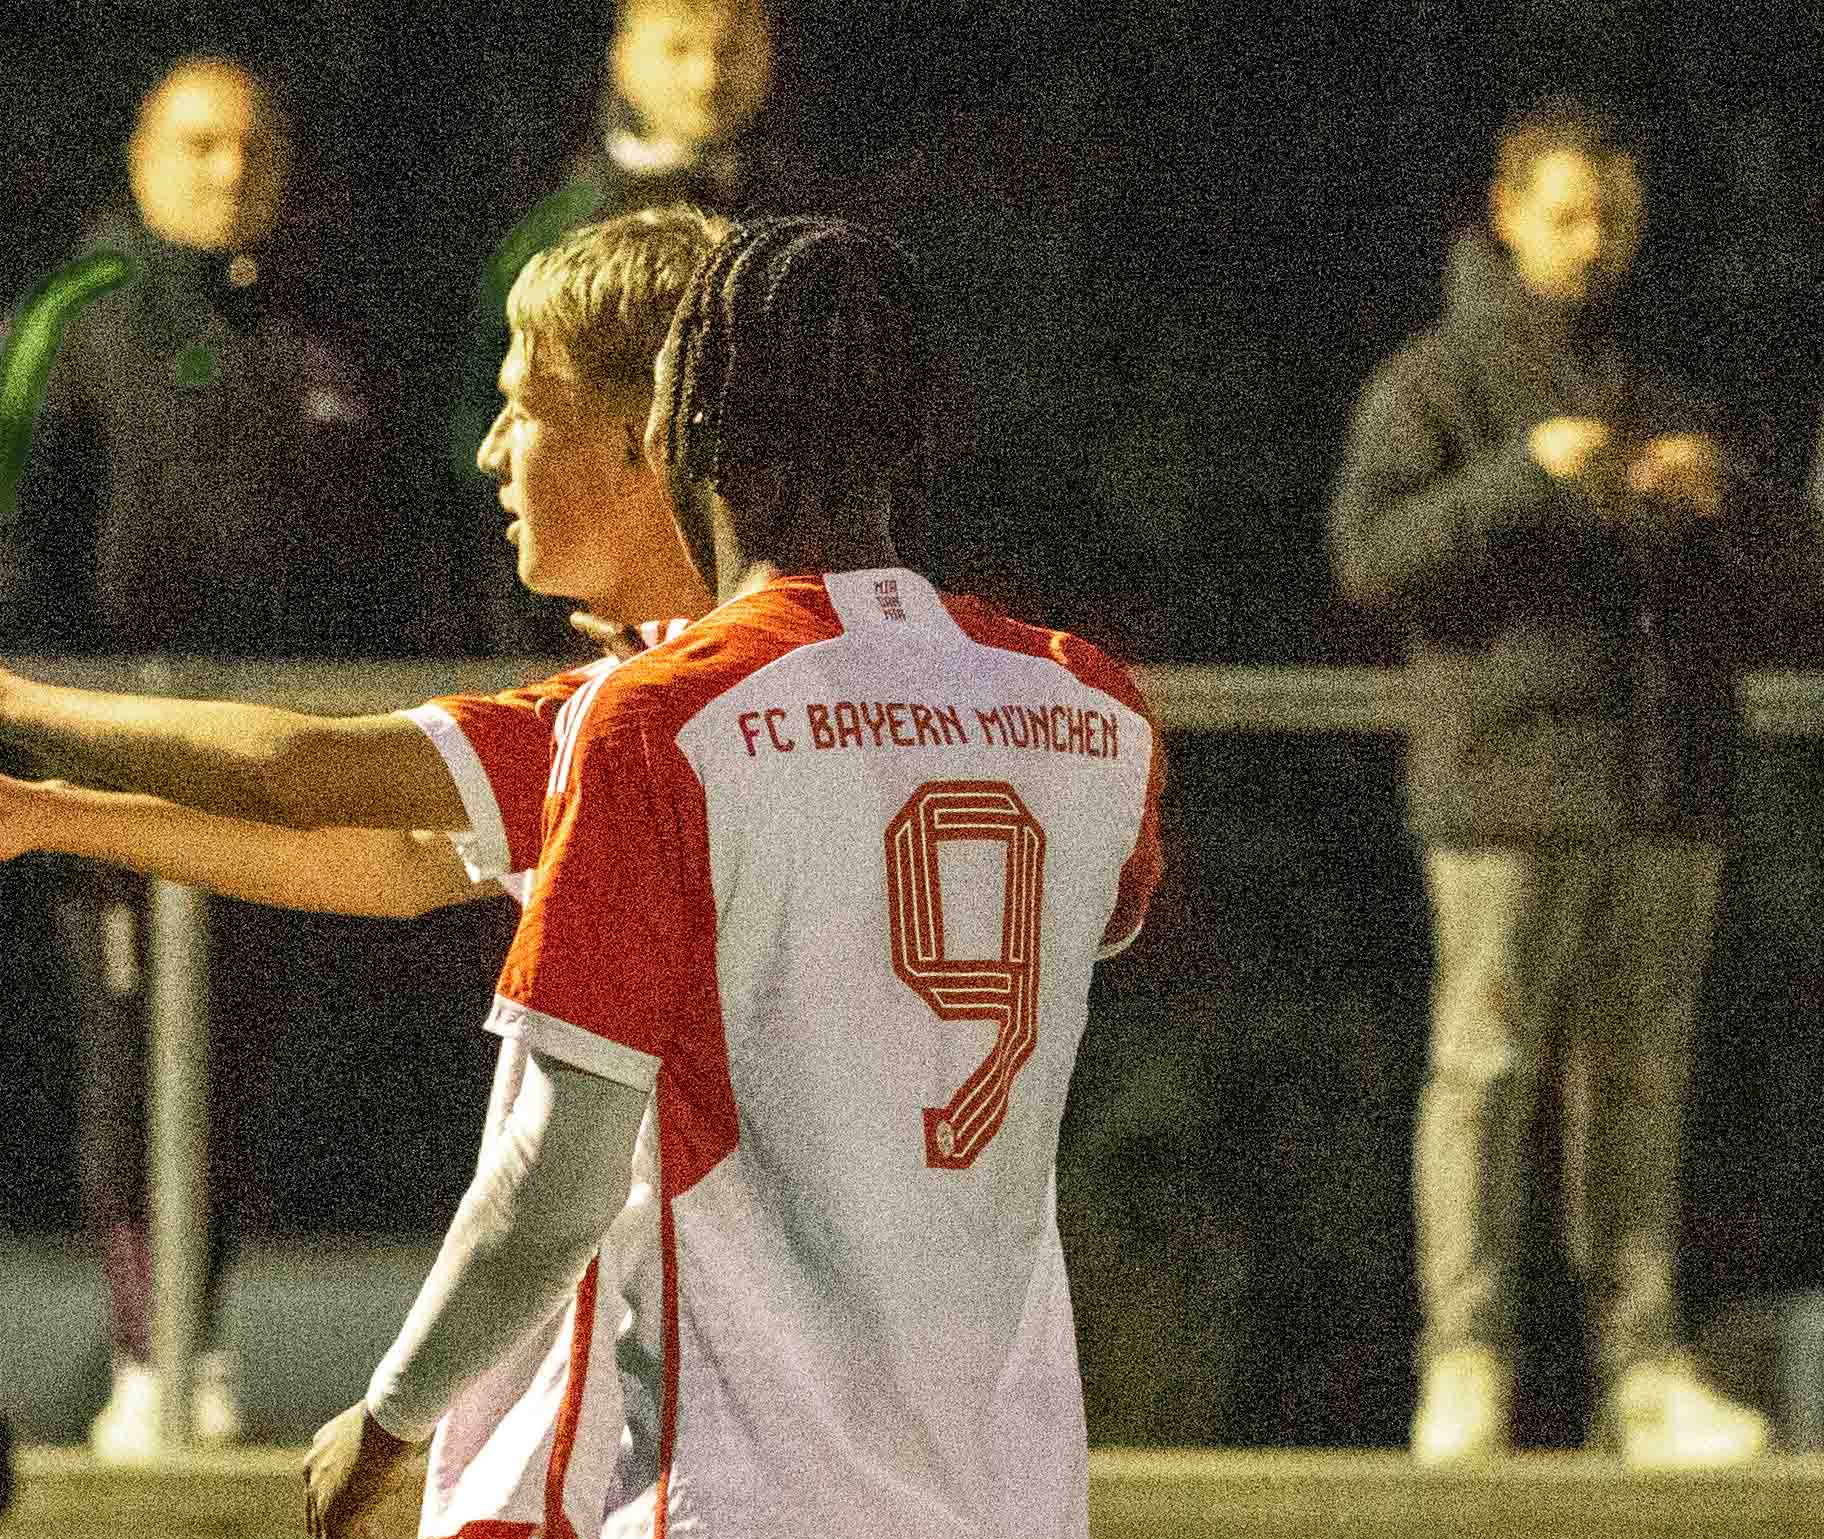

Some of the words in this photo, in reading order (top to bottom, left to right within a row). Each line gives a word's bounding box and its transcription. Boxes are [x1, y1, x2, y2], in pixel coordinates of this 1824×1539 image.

[737, 707, 795, 758] FC
[807, 701, 970, 750] BAYERN
[974, 703, 1120, 760] MÜNCHEN
[884, 779, 1046, 1169] 9
